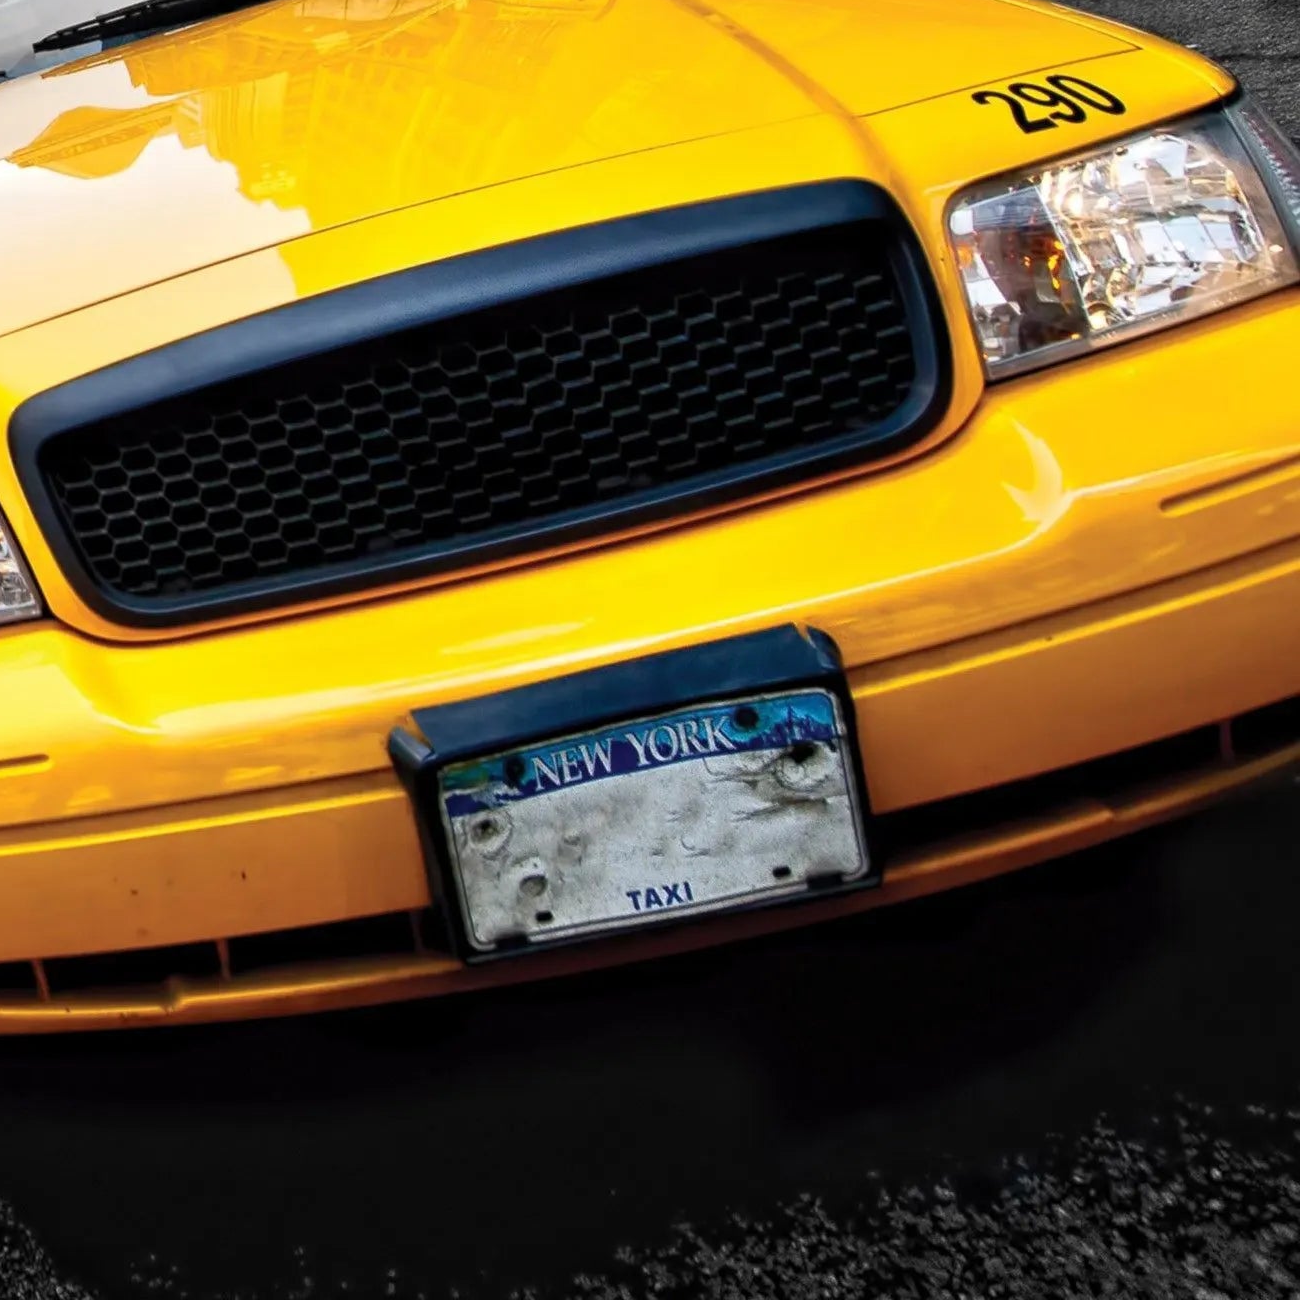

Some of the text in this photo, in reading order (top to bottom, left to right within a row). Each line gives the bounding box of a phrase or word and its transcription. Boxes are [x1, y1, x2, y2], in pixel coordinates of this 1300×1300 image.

[971, 75, 1126, 134] 290
[532, 715, 738, 792] NEW YORK
[626, 880, 694, 912] TAXI
